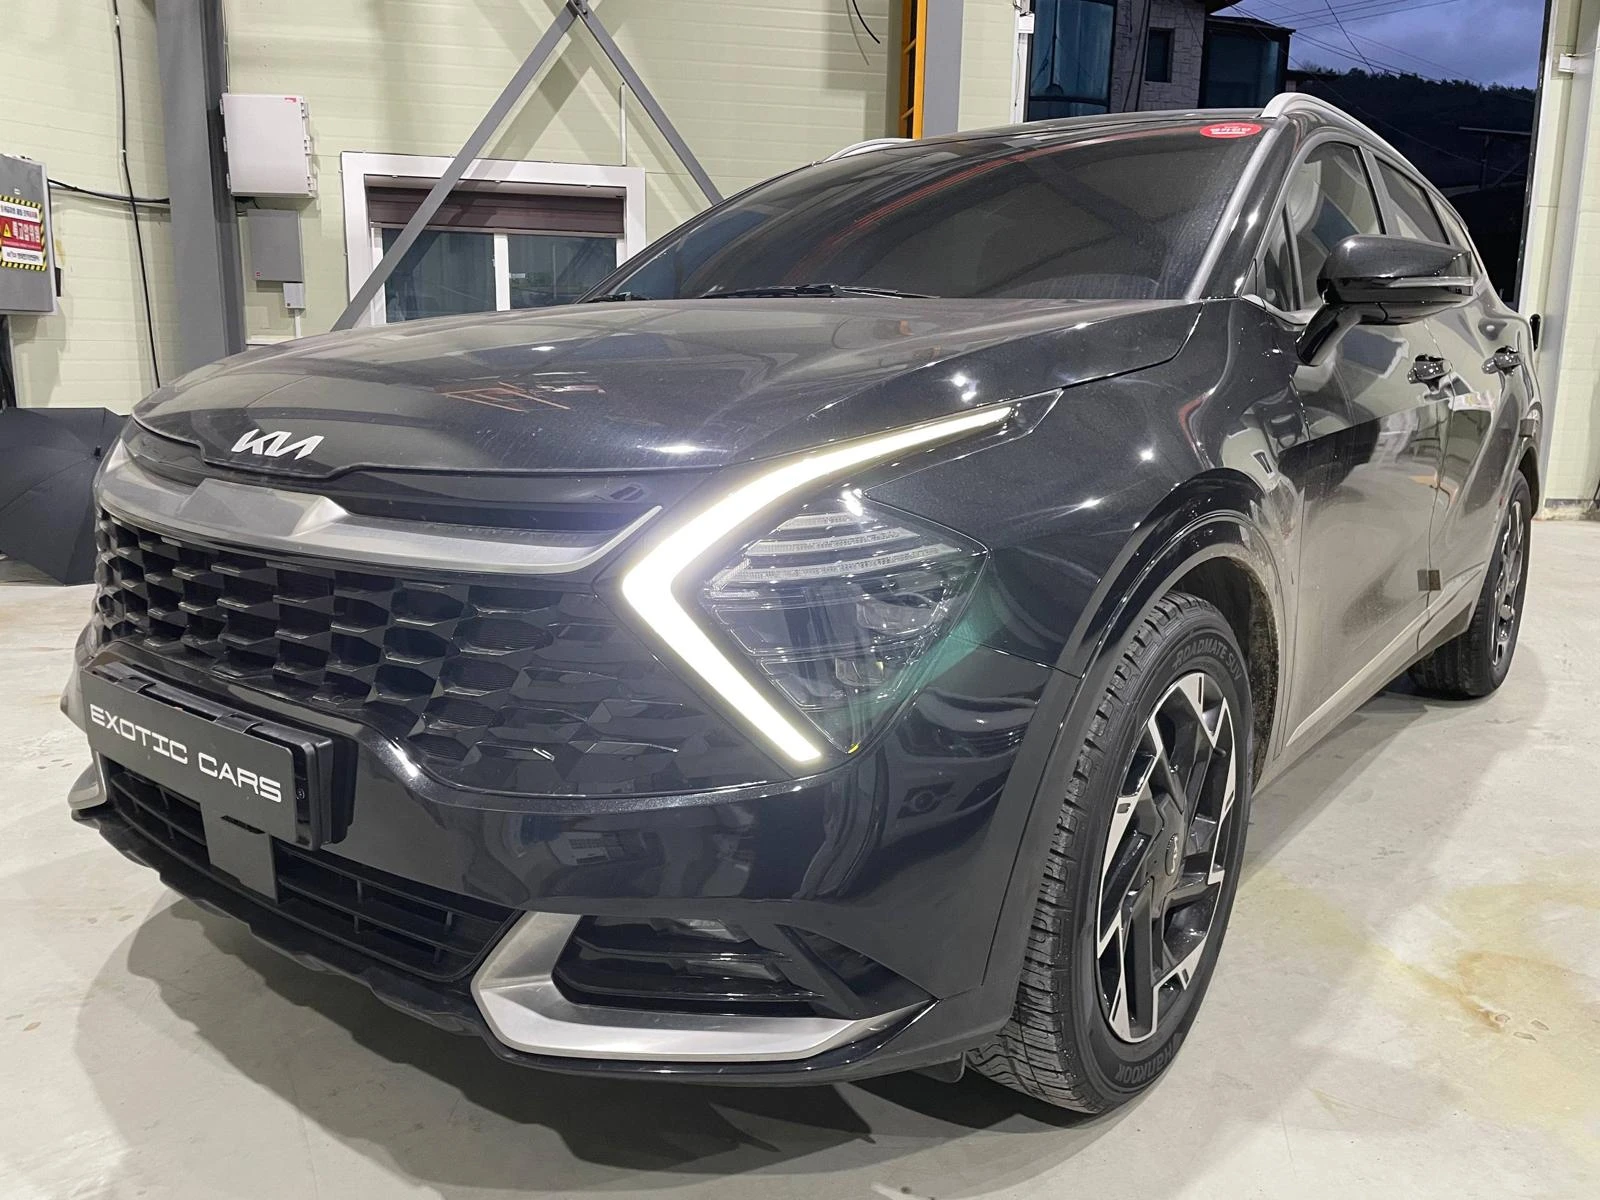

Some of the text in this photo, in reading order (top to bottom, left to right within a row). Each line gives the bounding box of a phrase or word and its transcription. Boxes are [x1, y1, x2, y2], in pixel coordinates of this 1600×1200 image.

[231, 428, 325, 460] KIA
[1225, 652, 1243, 681] SUV
[90, 703, 282, 803] EXOTIC CARS
